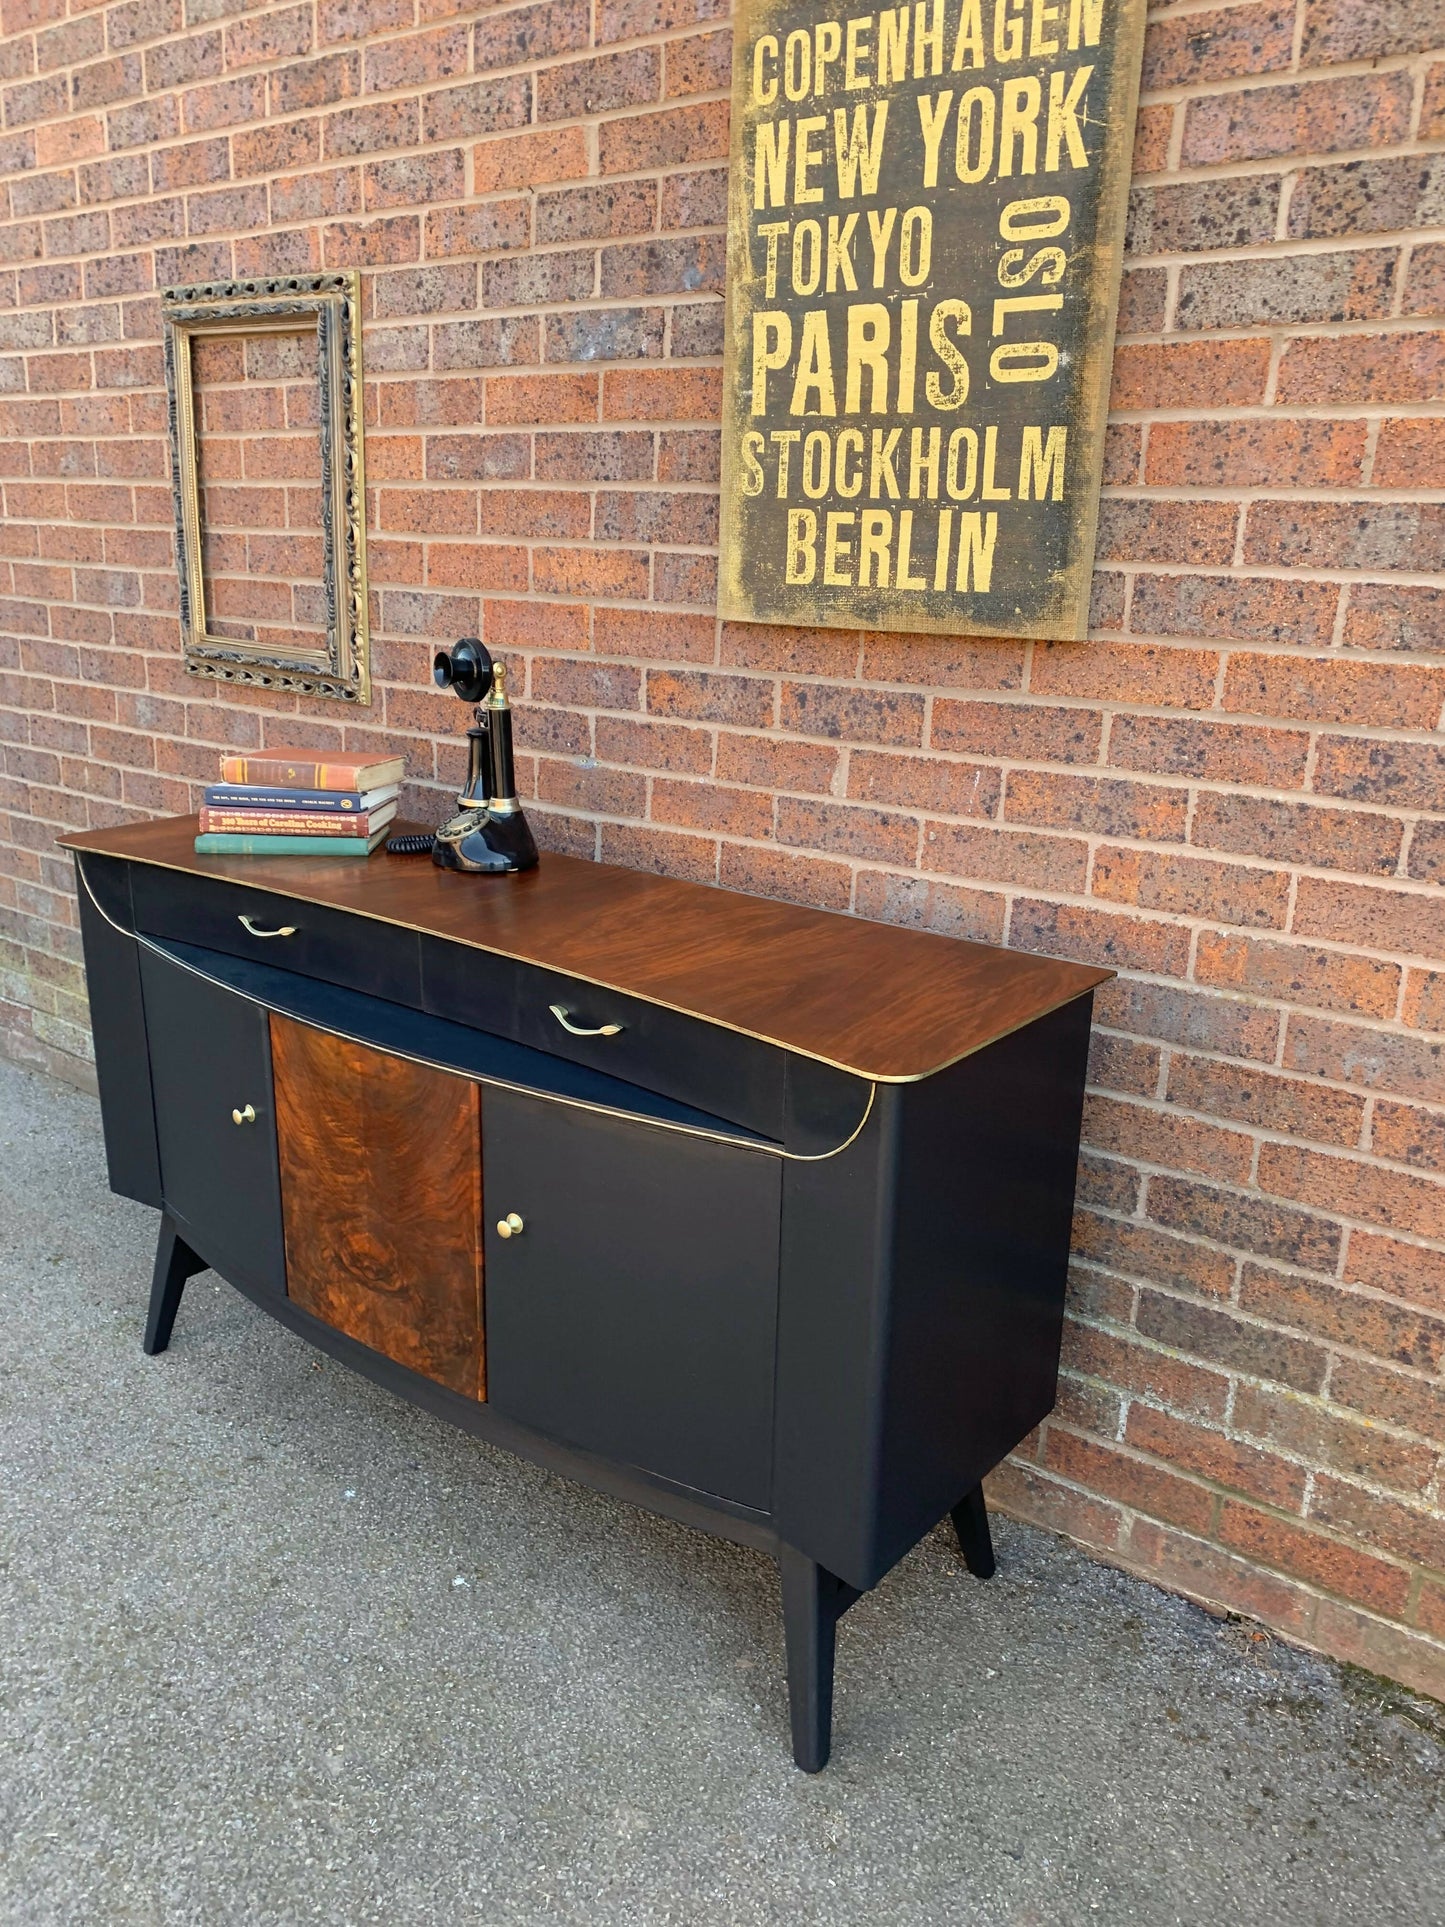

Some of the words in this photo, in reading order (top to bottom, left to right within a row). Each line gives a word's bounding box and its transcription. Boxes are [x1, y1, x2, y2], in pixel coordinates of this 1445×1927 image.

[753, 0, 1104, 105] COPENHAGEN
[754, 100, 888, 210] NEW
[917, 65, 1095, 188] YORK
[757, 206, 933, 299] TOKYO
[990, 195, 1070, 383] OSLO
[751, 299, 972, 417] PARIS
[740, 426, 1068, 501] STOCKHOLM
[785, 508, 998, 593] BERLIN
[258, 819, 269, 827] of
[268, 819, 306, 829] Carolina
[306, 820, 342, 831] Cooking
